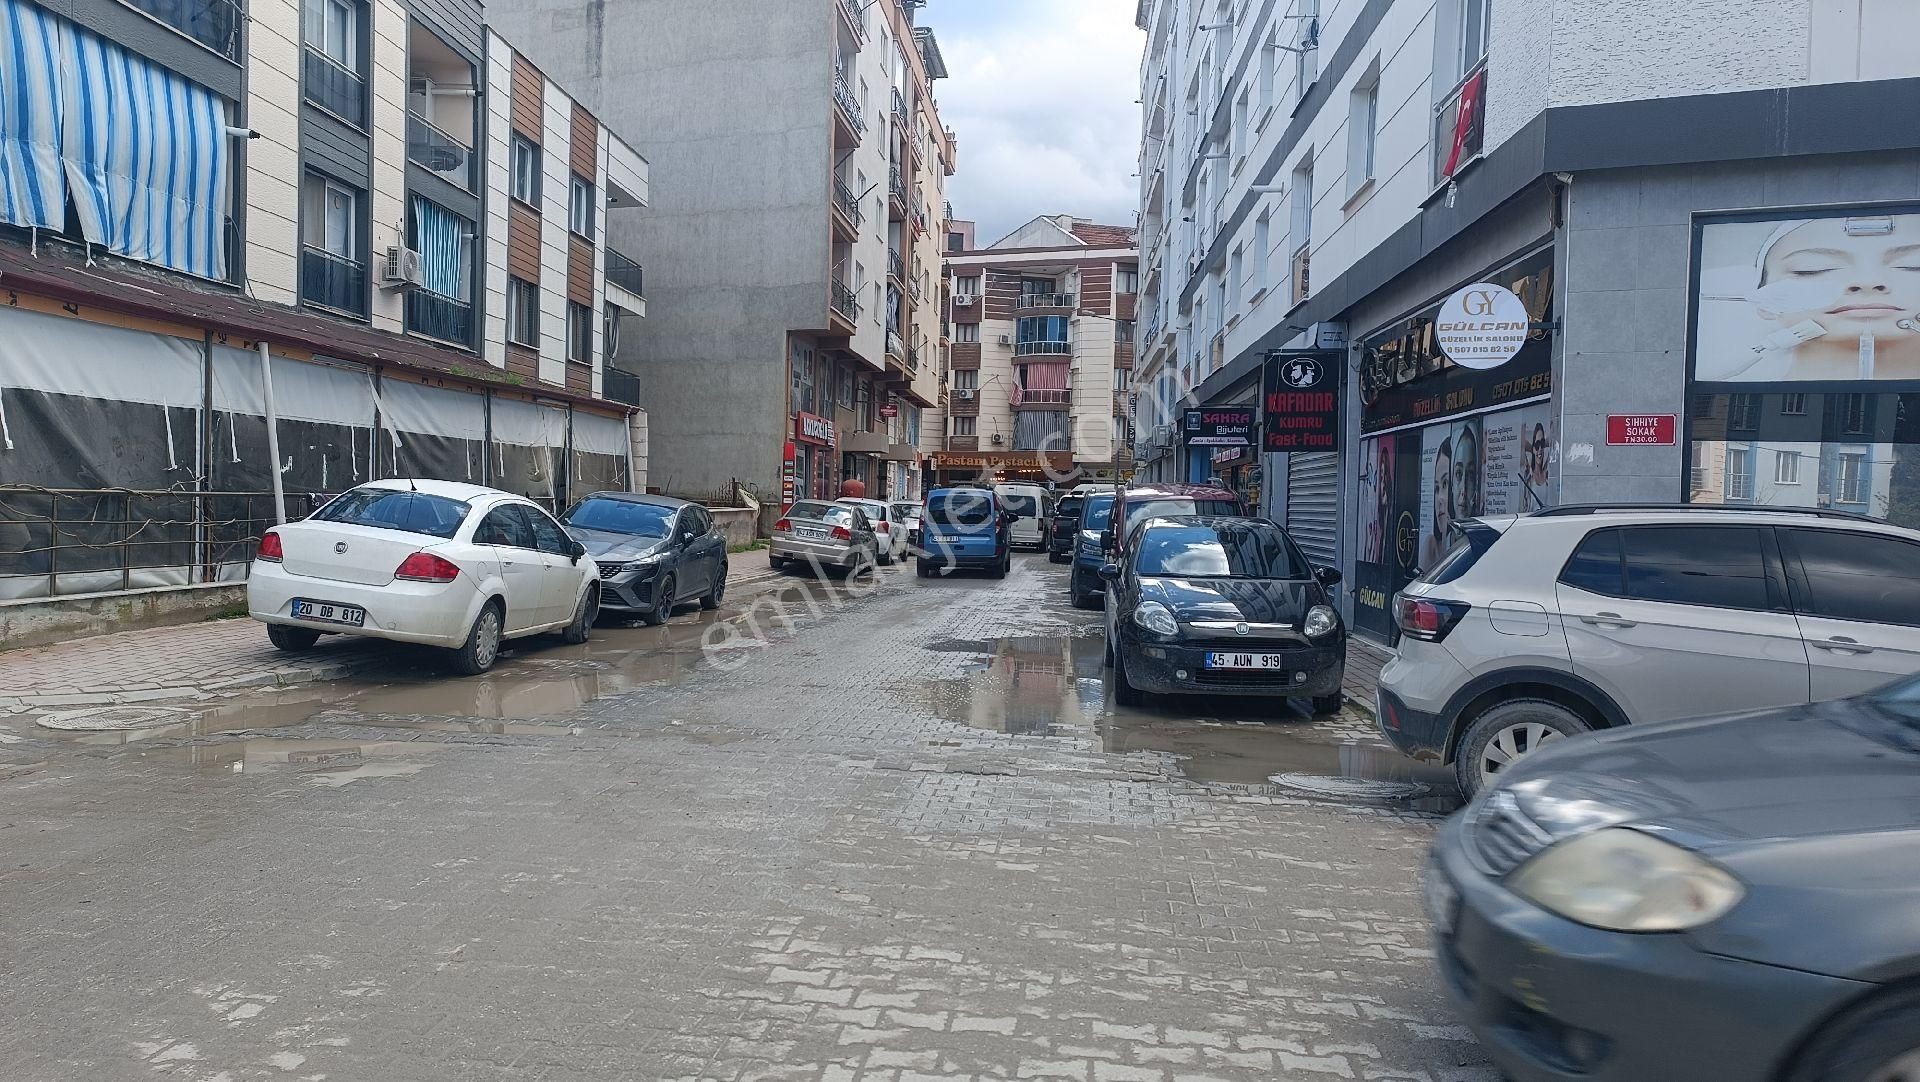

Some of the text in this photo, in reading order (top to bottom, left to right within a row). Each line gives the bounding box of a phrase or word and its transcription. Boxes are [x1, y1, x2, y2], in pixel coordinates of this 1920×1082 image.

[1462, 290, 1502, 316] GY
[1439, 321, 1526, 332] GÜLCAN
[1267, 392, 1334, 412] KAFADAR
[1202, 413, 1250, 424] SAHRA
[1279, 416, 1323, 429] KUMRU
[1216, 425, 1249, 435] Bijuteri
[1626, 427, 1656, 436] SOKAK
[936, 454, 986, 466] Pastam
[1360, 585, 1386, 610] GÜLCAN
[299, 602, 313, 615] 20
[319, 605, 334, 618] DB
[341, 608, 362, 622] 812
[1211, 653, 1280, 667] 45 AUN 919
